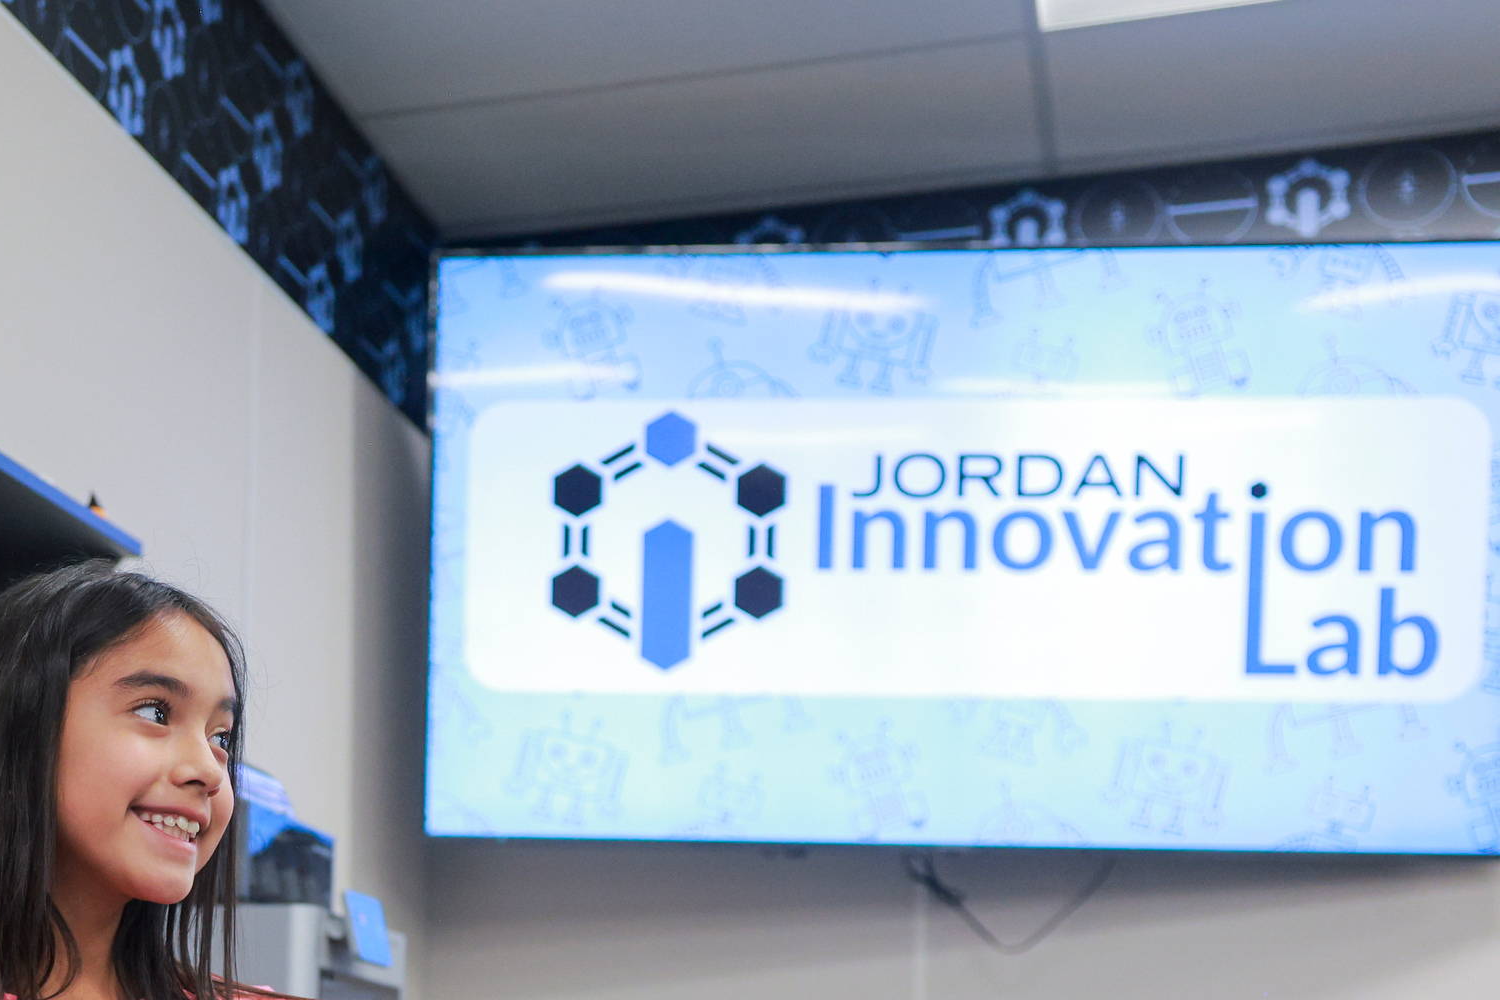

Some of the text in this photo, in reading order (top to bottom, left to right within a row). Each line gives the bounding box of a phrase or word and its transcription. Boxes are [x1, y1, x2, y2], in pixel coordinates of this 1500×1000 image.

[853, 454, 1185, 498] JORDAN
[817, 482, 1417, 573] Innovation
[1245, 587, 1440, 676] Lab
